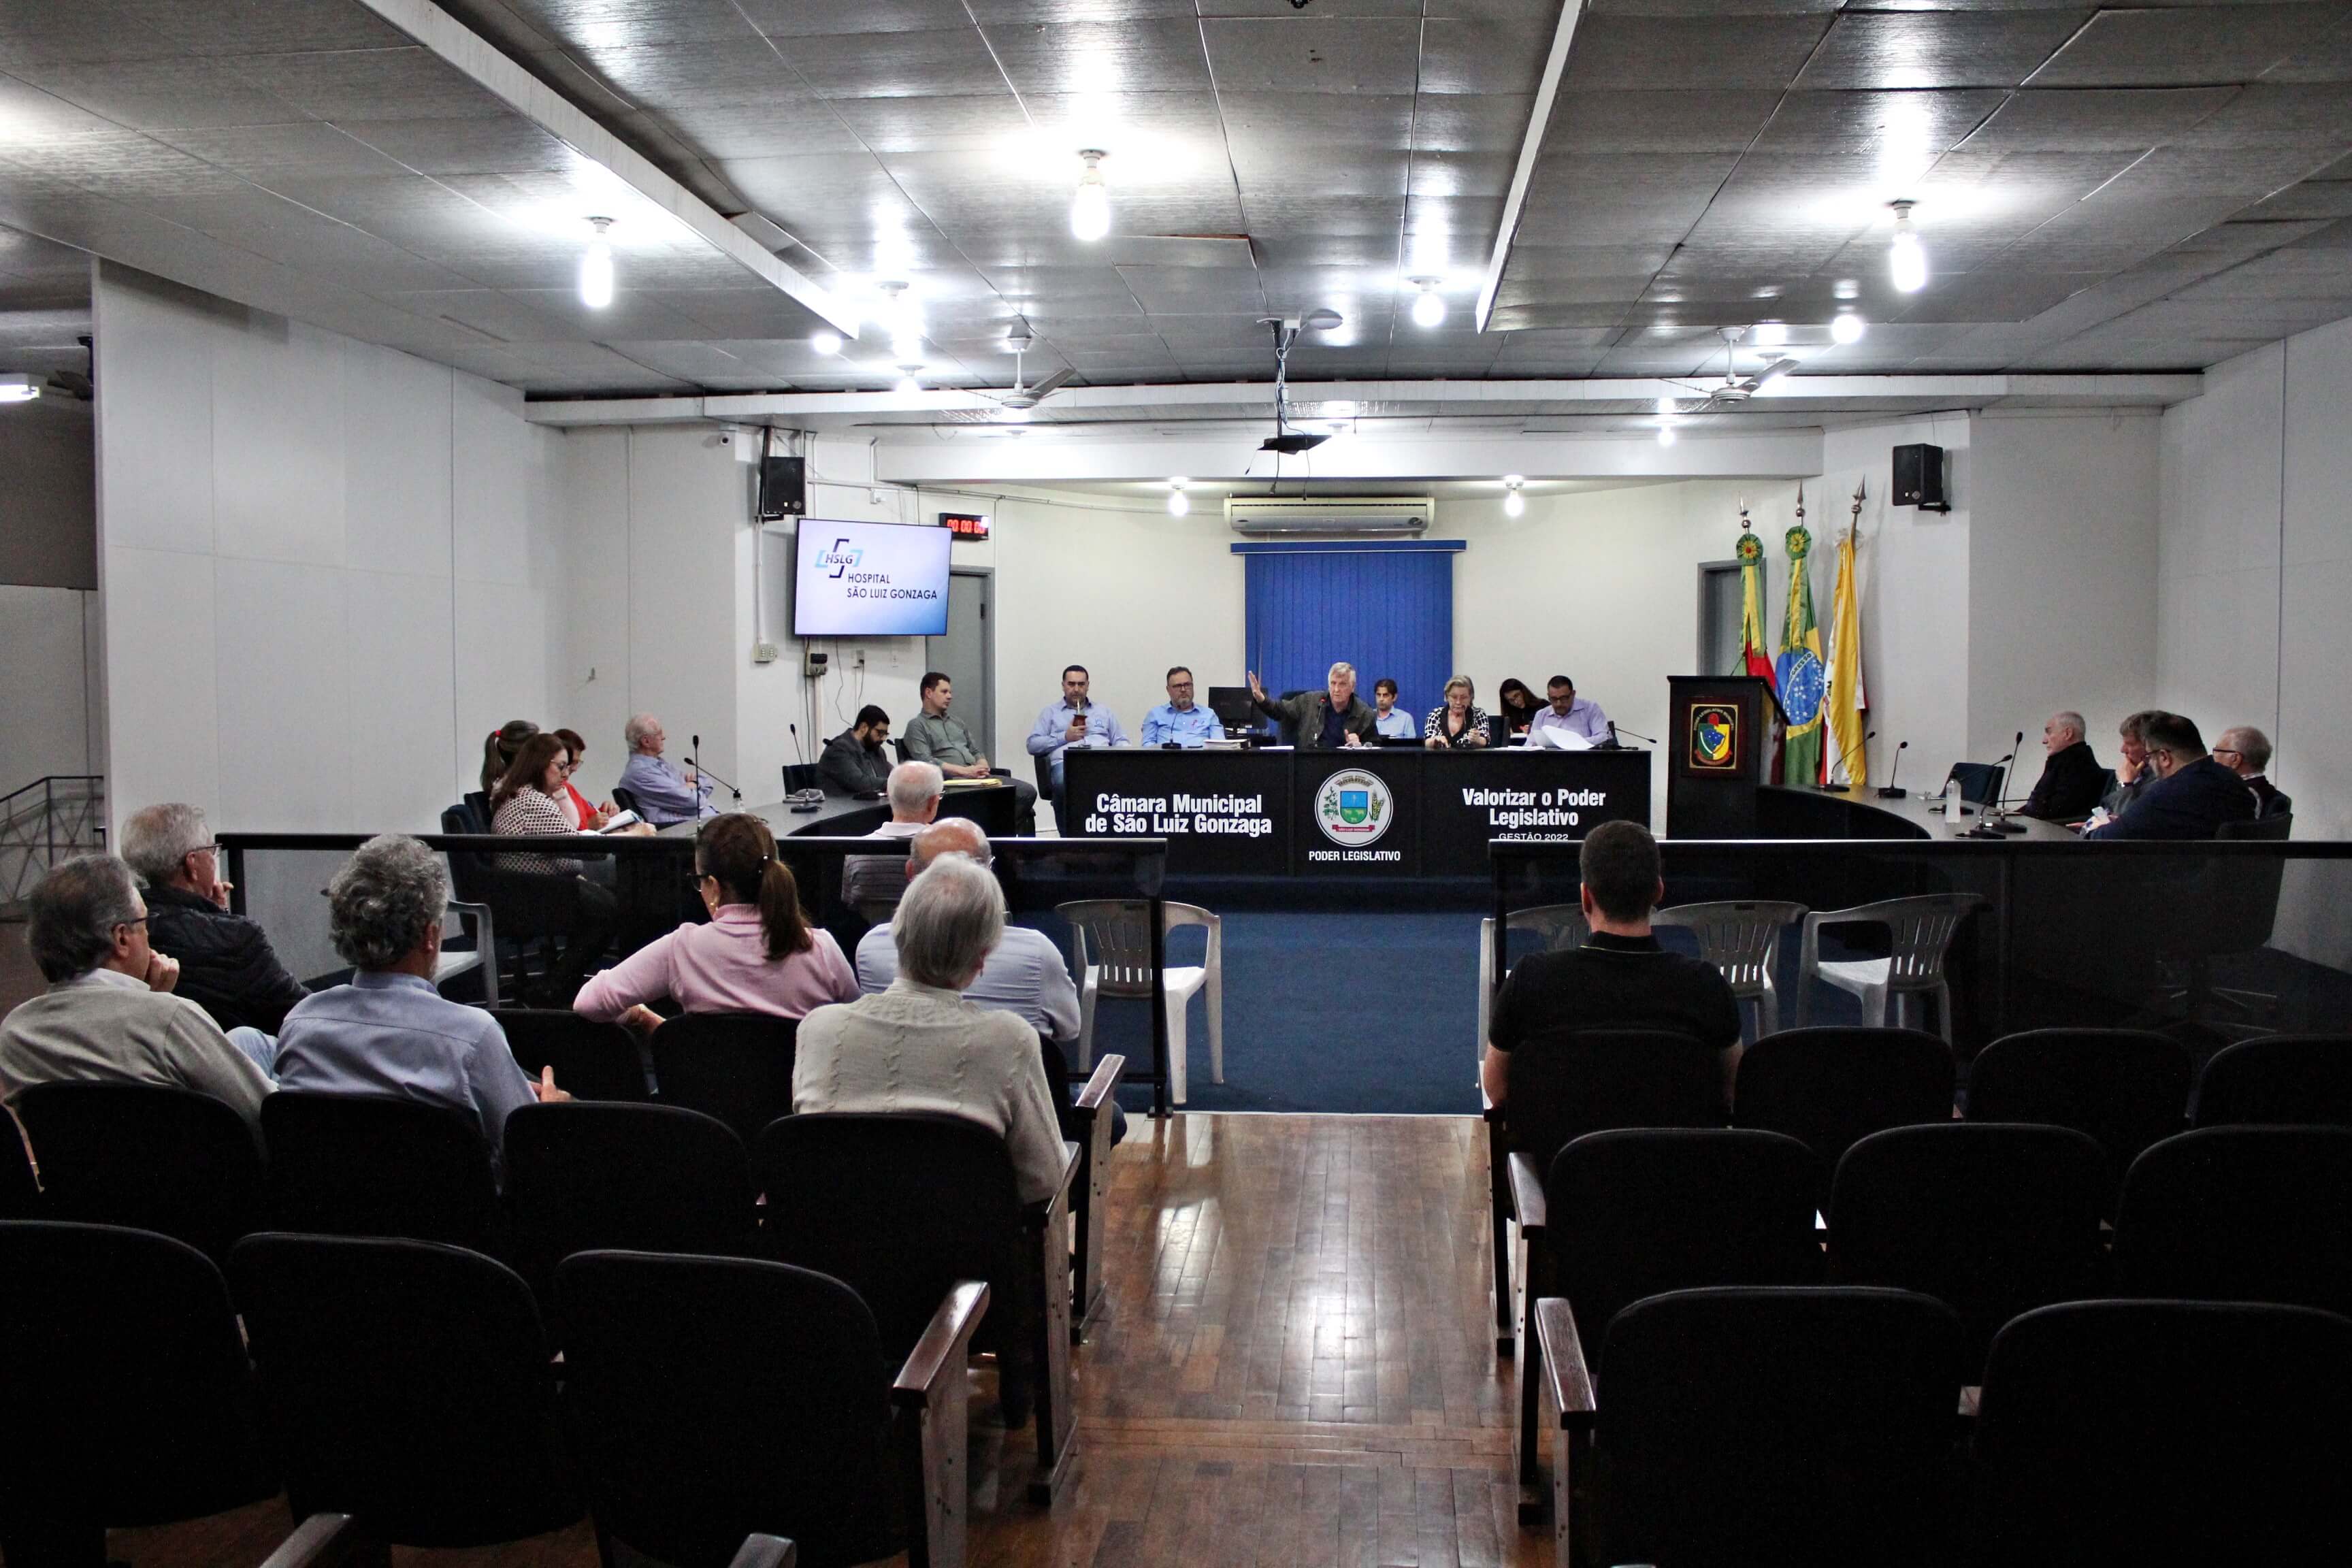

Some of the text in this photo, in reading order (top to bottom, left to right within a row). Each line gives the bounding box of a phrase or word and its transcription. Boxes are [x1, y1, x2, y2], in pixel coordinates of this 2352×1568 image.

[826, 553, 853, 564] HSLG
[847, 573, 891, 584] HOSPITAL
[847, 585, 938, 600] SÃO LUIZ GONZAGA
[1462, 787, 1607, 806] Valorizar o Poder
[1096, 793, 1262, 817] Câmara Municipal
[1085, 813, 1272, 838] de São Luiz Gonzaga
[1489, 808, 1579, 830] Legislativo
[1499, 832, 1542, 840] GESTÃO
[1308, 850, 1401, 862] PODER LEGISLATIVO
